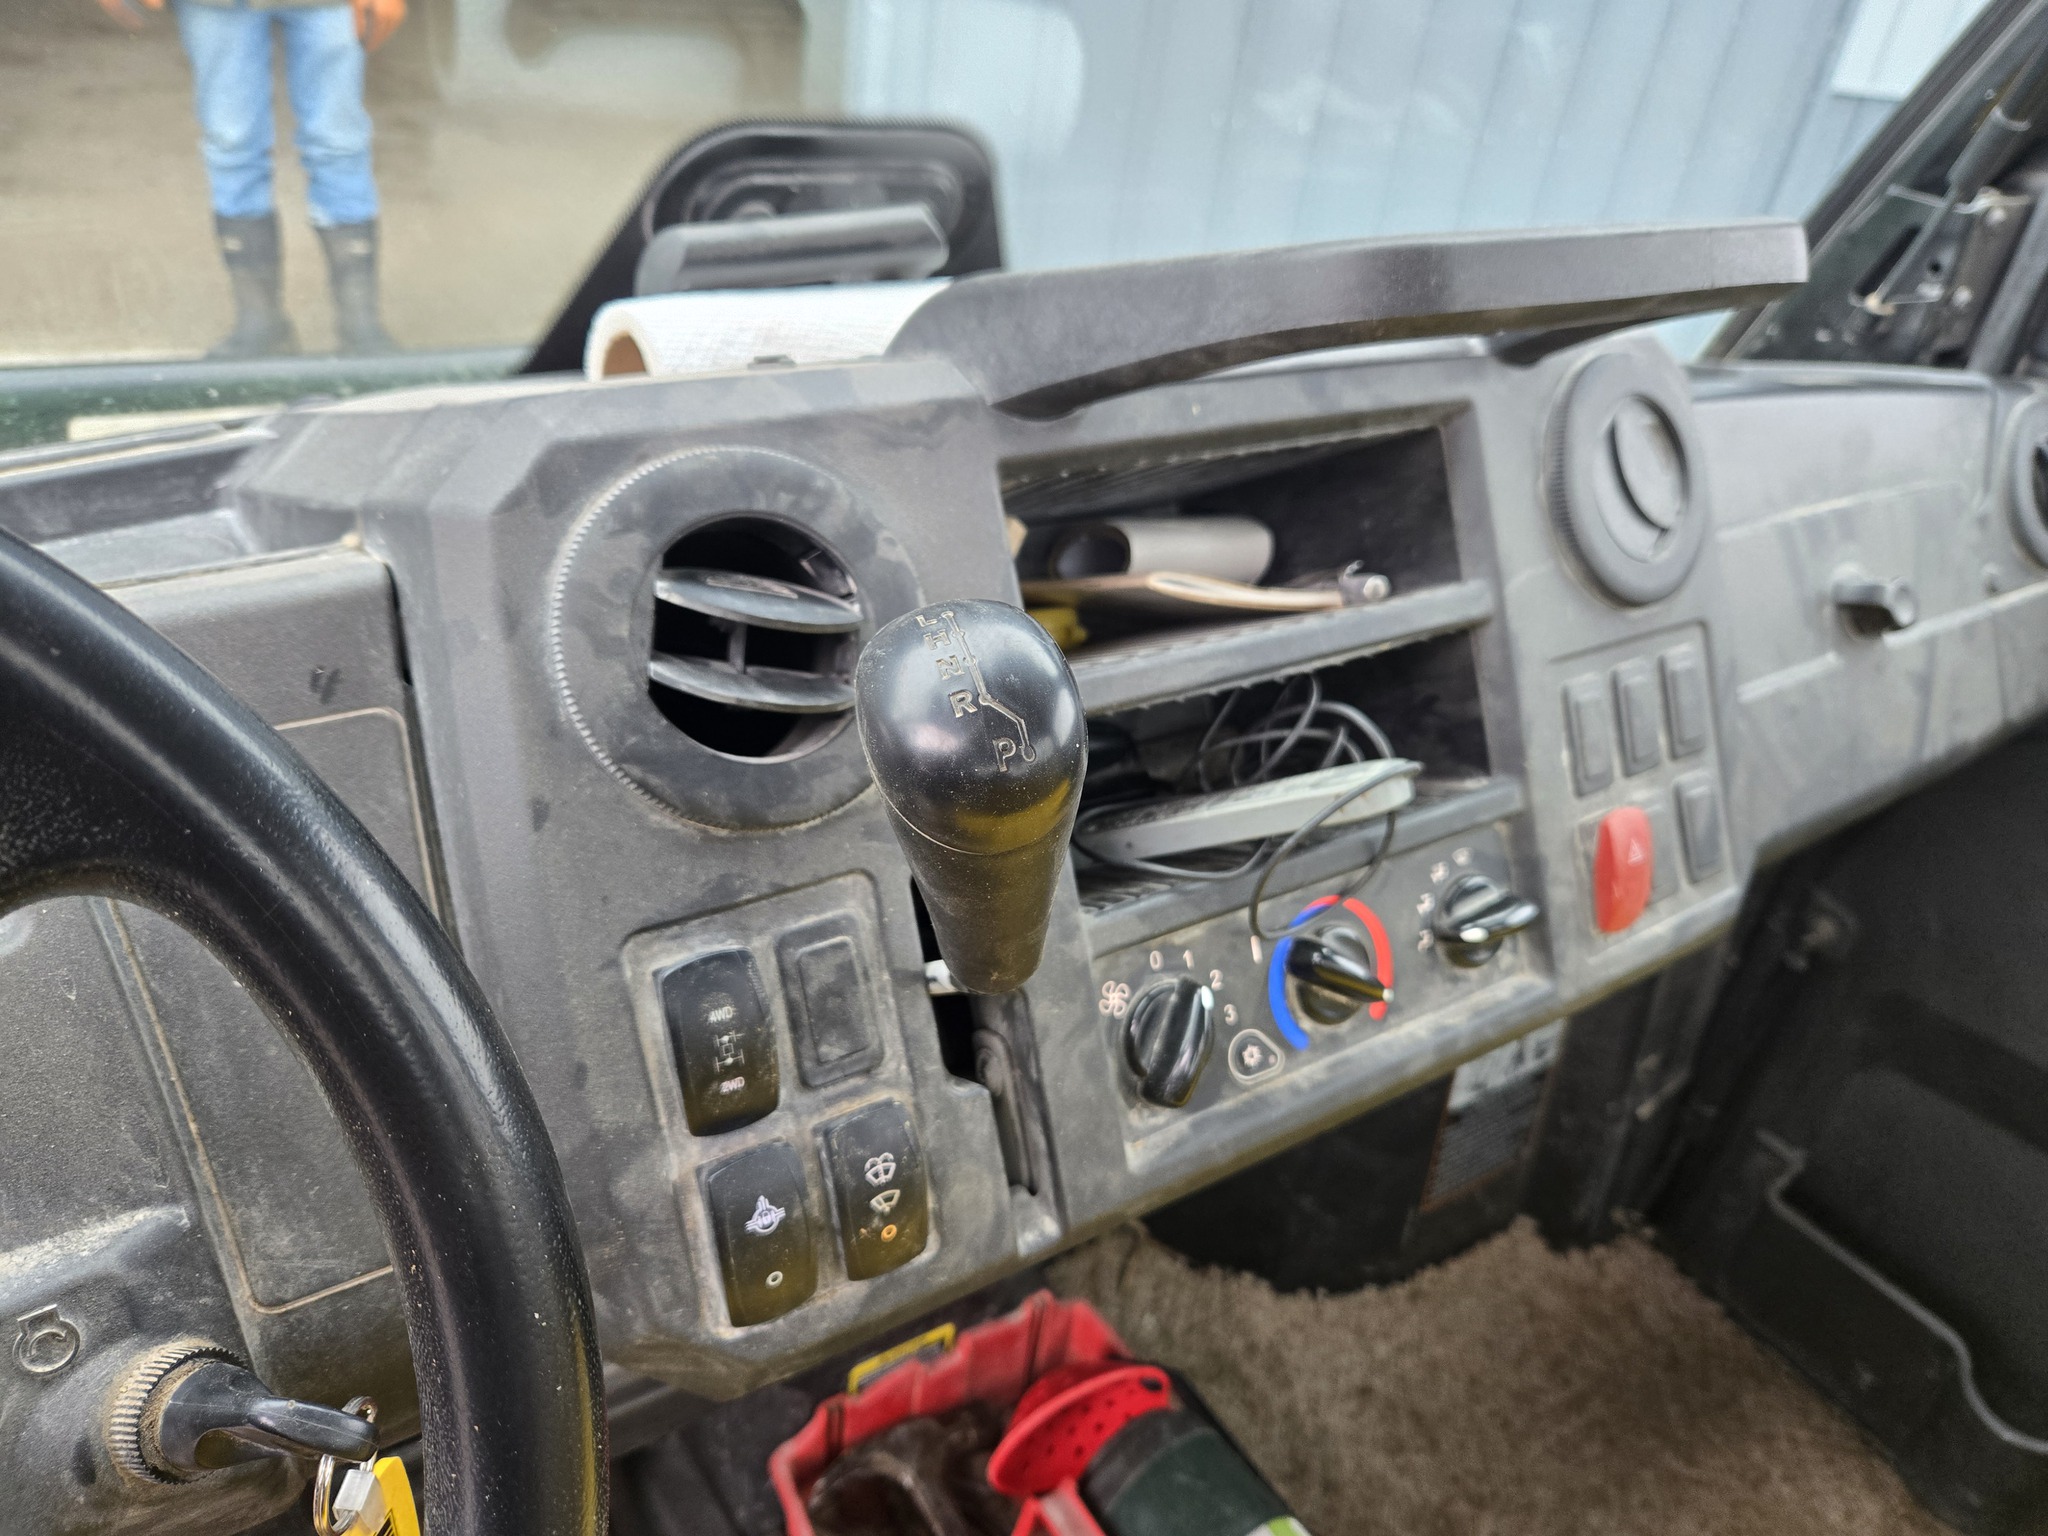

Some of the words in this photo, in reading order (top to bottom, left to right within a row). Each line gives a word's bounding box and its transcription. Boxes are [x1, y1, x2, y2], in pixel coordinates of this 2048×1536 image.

[923, 629, 952, 651] H
[935, 654, 965, 681] N
[948, 689, 978, 718] R
[992, 737, 1017, 772] P
[1149, 950, 1164, 972] 0
[1183, 949, 1195, 970] 1
[1209, 968, 1225, 990] 2
[708, 1006, 734, 1023] 4WD
[1223, 1003, 1239, 1026] 3
[719, 1076, 745, 1094] 2WD
